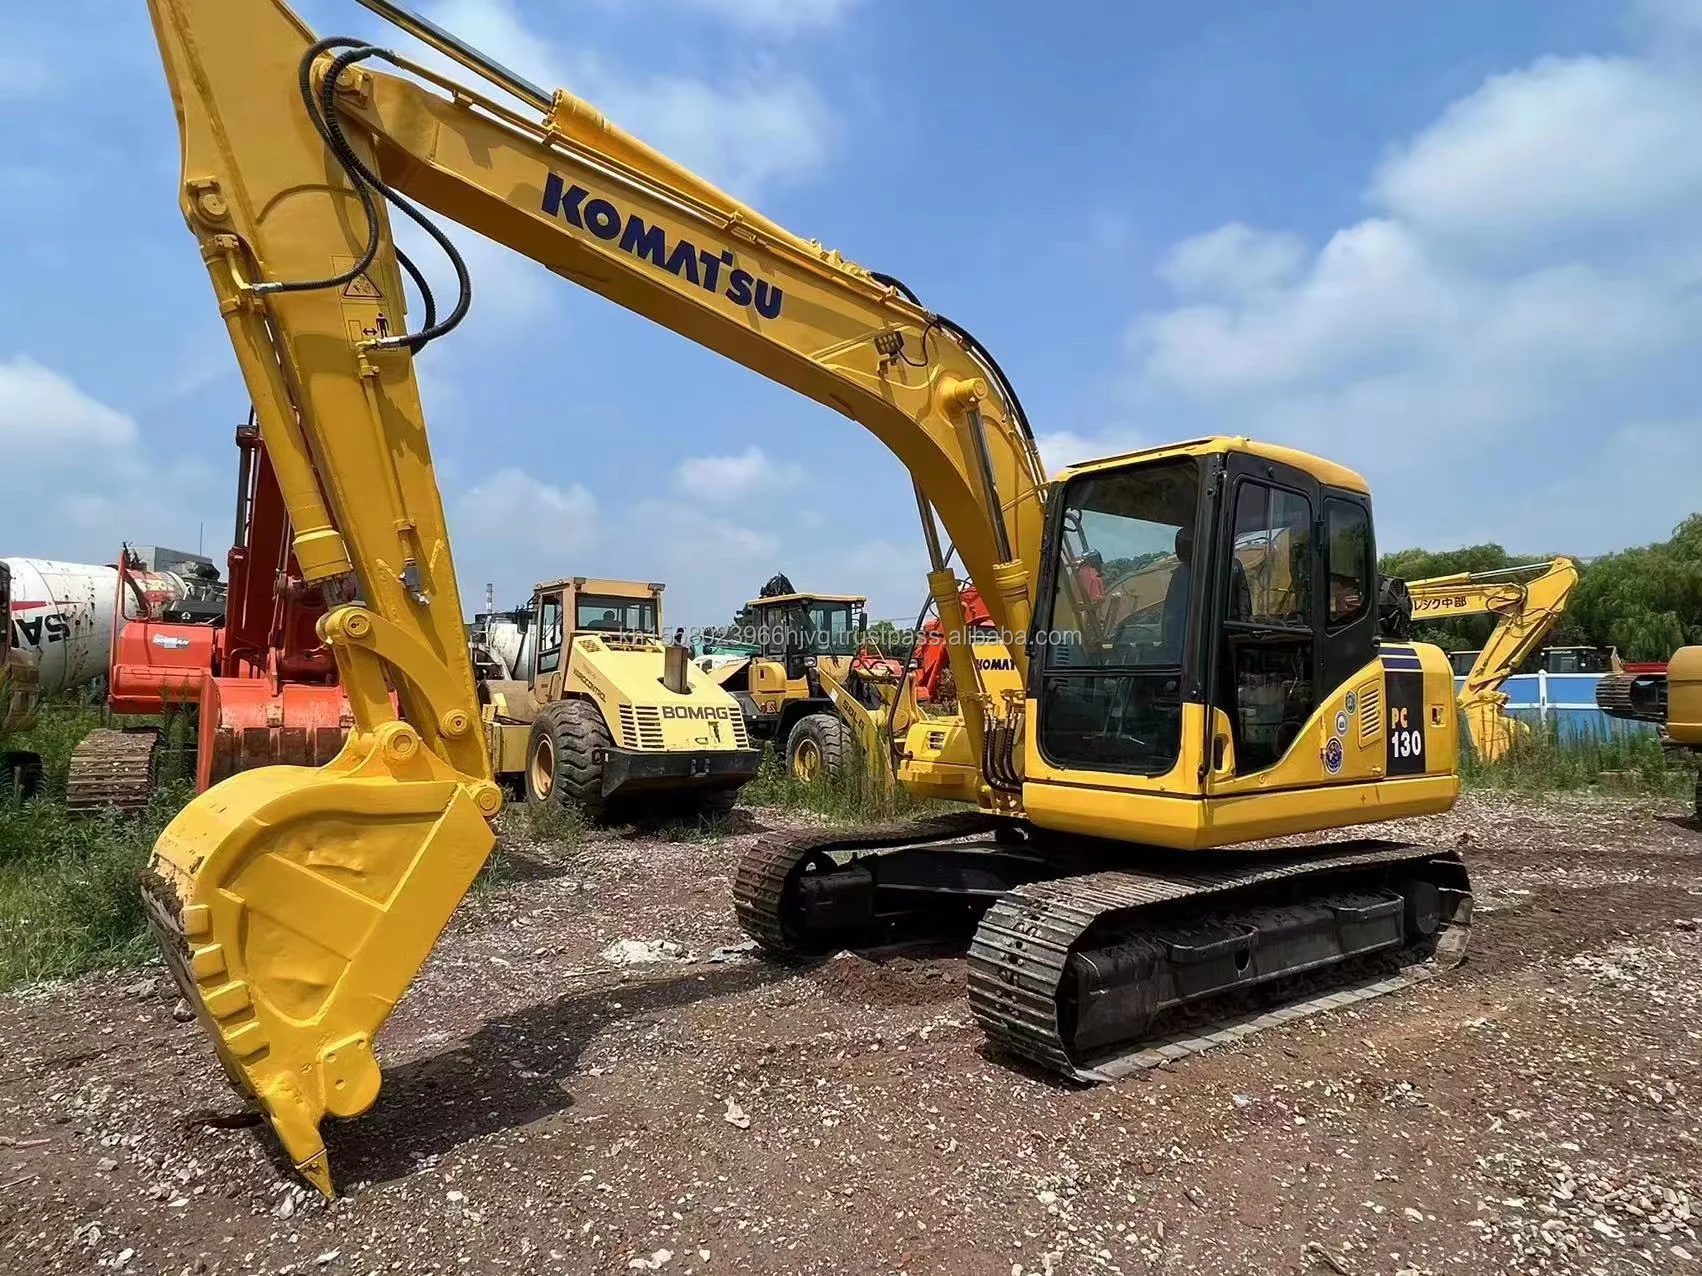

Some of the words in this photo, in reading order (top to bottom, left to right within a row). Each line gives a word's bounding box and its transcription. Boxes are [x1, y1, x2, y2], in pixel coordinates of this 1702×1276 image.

[541, 172, 783, 320] KOMATSU
[661, 705, 729, 719] BOMAG
[842, 699, 866, 731] SDLG
[1391, 707, 1408, 729] PC
[1391, 730, 1422, 758] 130
